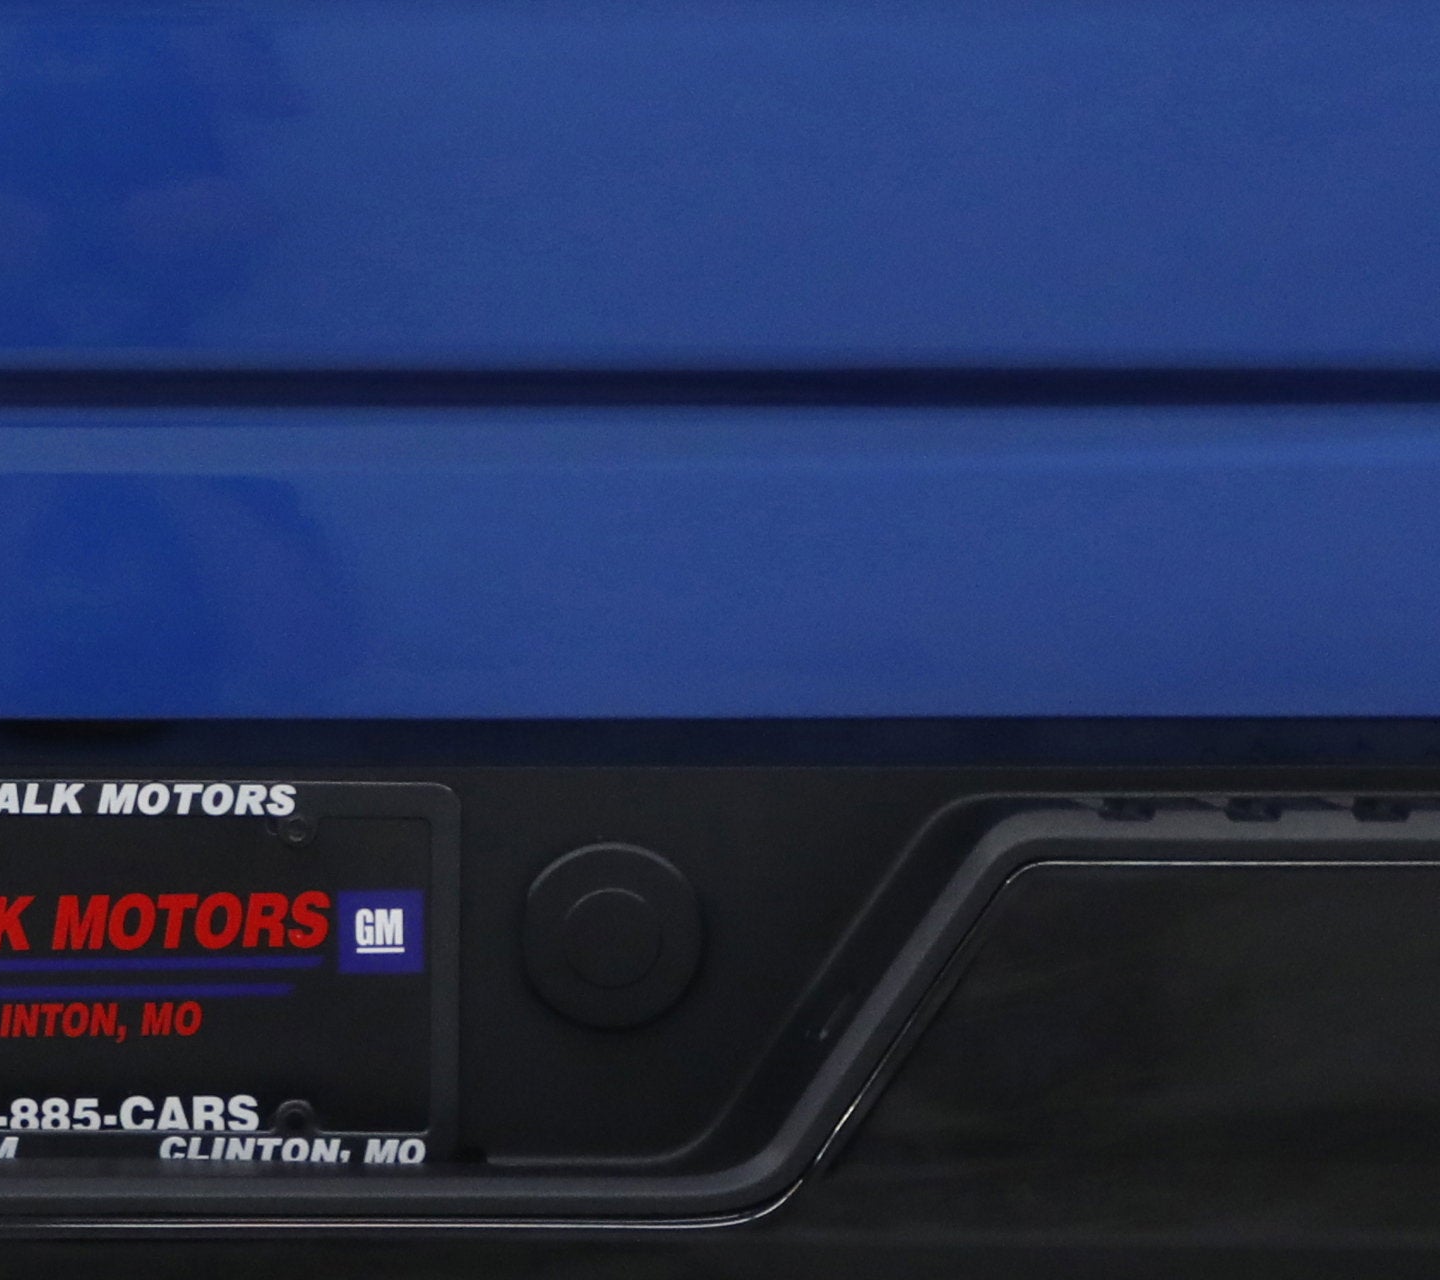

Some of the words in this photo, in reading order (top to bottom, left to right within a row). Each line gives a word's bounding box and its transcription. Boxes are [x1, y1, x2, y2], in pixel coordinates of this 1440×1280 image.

[96, 782, 297, 817] MOTORS
[51, 890, 331, 951] MOTORS
[354, 907, 404, 947] GM
[141, 1001, 203, 1037] MO
[158, 1135, 351, 1164] CLINTON,
[363, 1138, 426, 1165] MO
